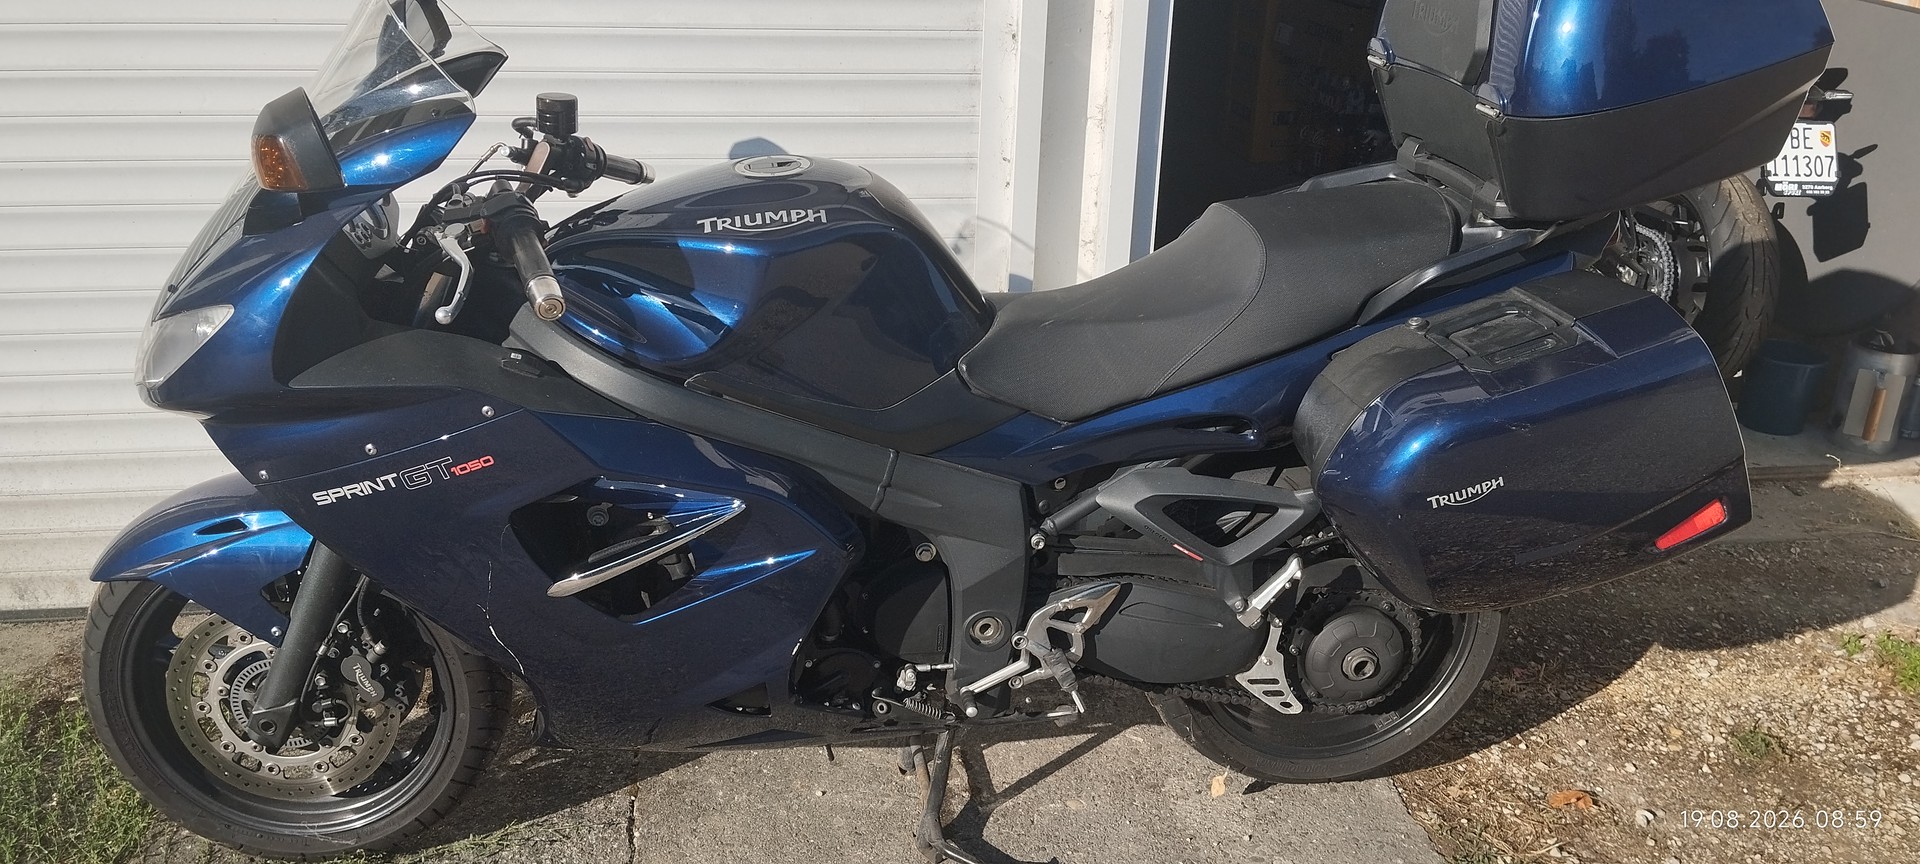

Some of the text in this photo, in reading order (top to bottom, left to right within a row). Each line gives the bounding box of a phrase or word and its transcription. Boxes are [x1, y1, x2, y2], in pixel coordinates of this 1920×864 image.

[1790, 127, 1813, 149] BE
[1773, 154, 1834, 177] 111307
[697, 209, 828, 234] TRIUMPH
[312, 455, 495, 506] SPRINT GT 1050
[1426, 476, 1504, 509] TRIUMPH
[353, 662, 378, 697] TRIUMPH
